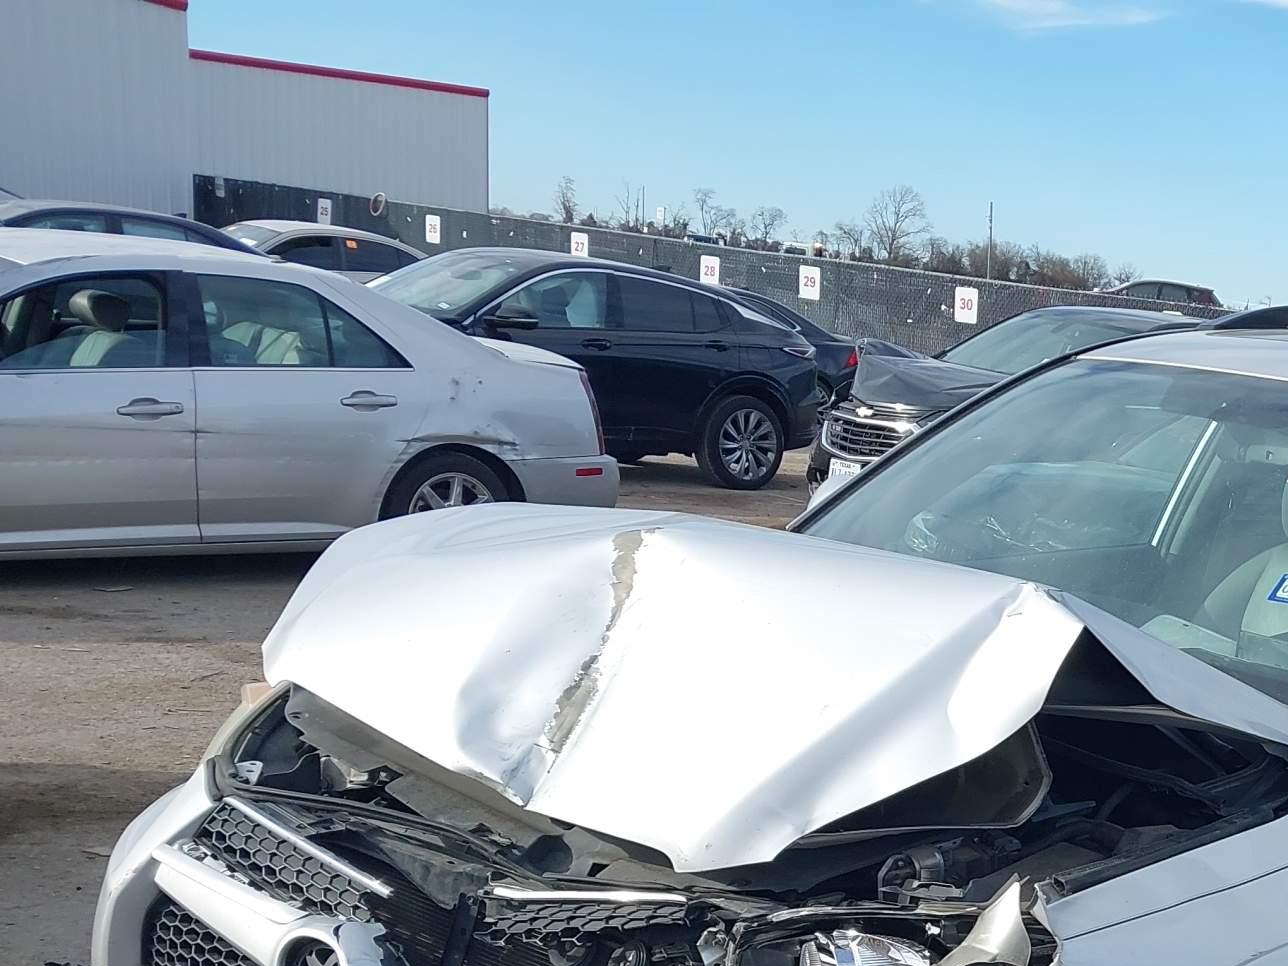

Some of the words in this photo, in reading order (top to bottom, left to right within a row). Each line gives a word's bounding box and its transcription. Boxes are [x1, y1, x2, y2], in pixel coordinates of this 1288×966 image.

[319, 206, 329, 216] 25
[428, 224, 438, 234] 26
[574, 241, 585, 252] 27
[703, 265, 716, 277] 28
[803, 275, 816, 288] 29
[959, 298, 973, 311] 30
